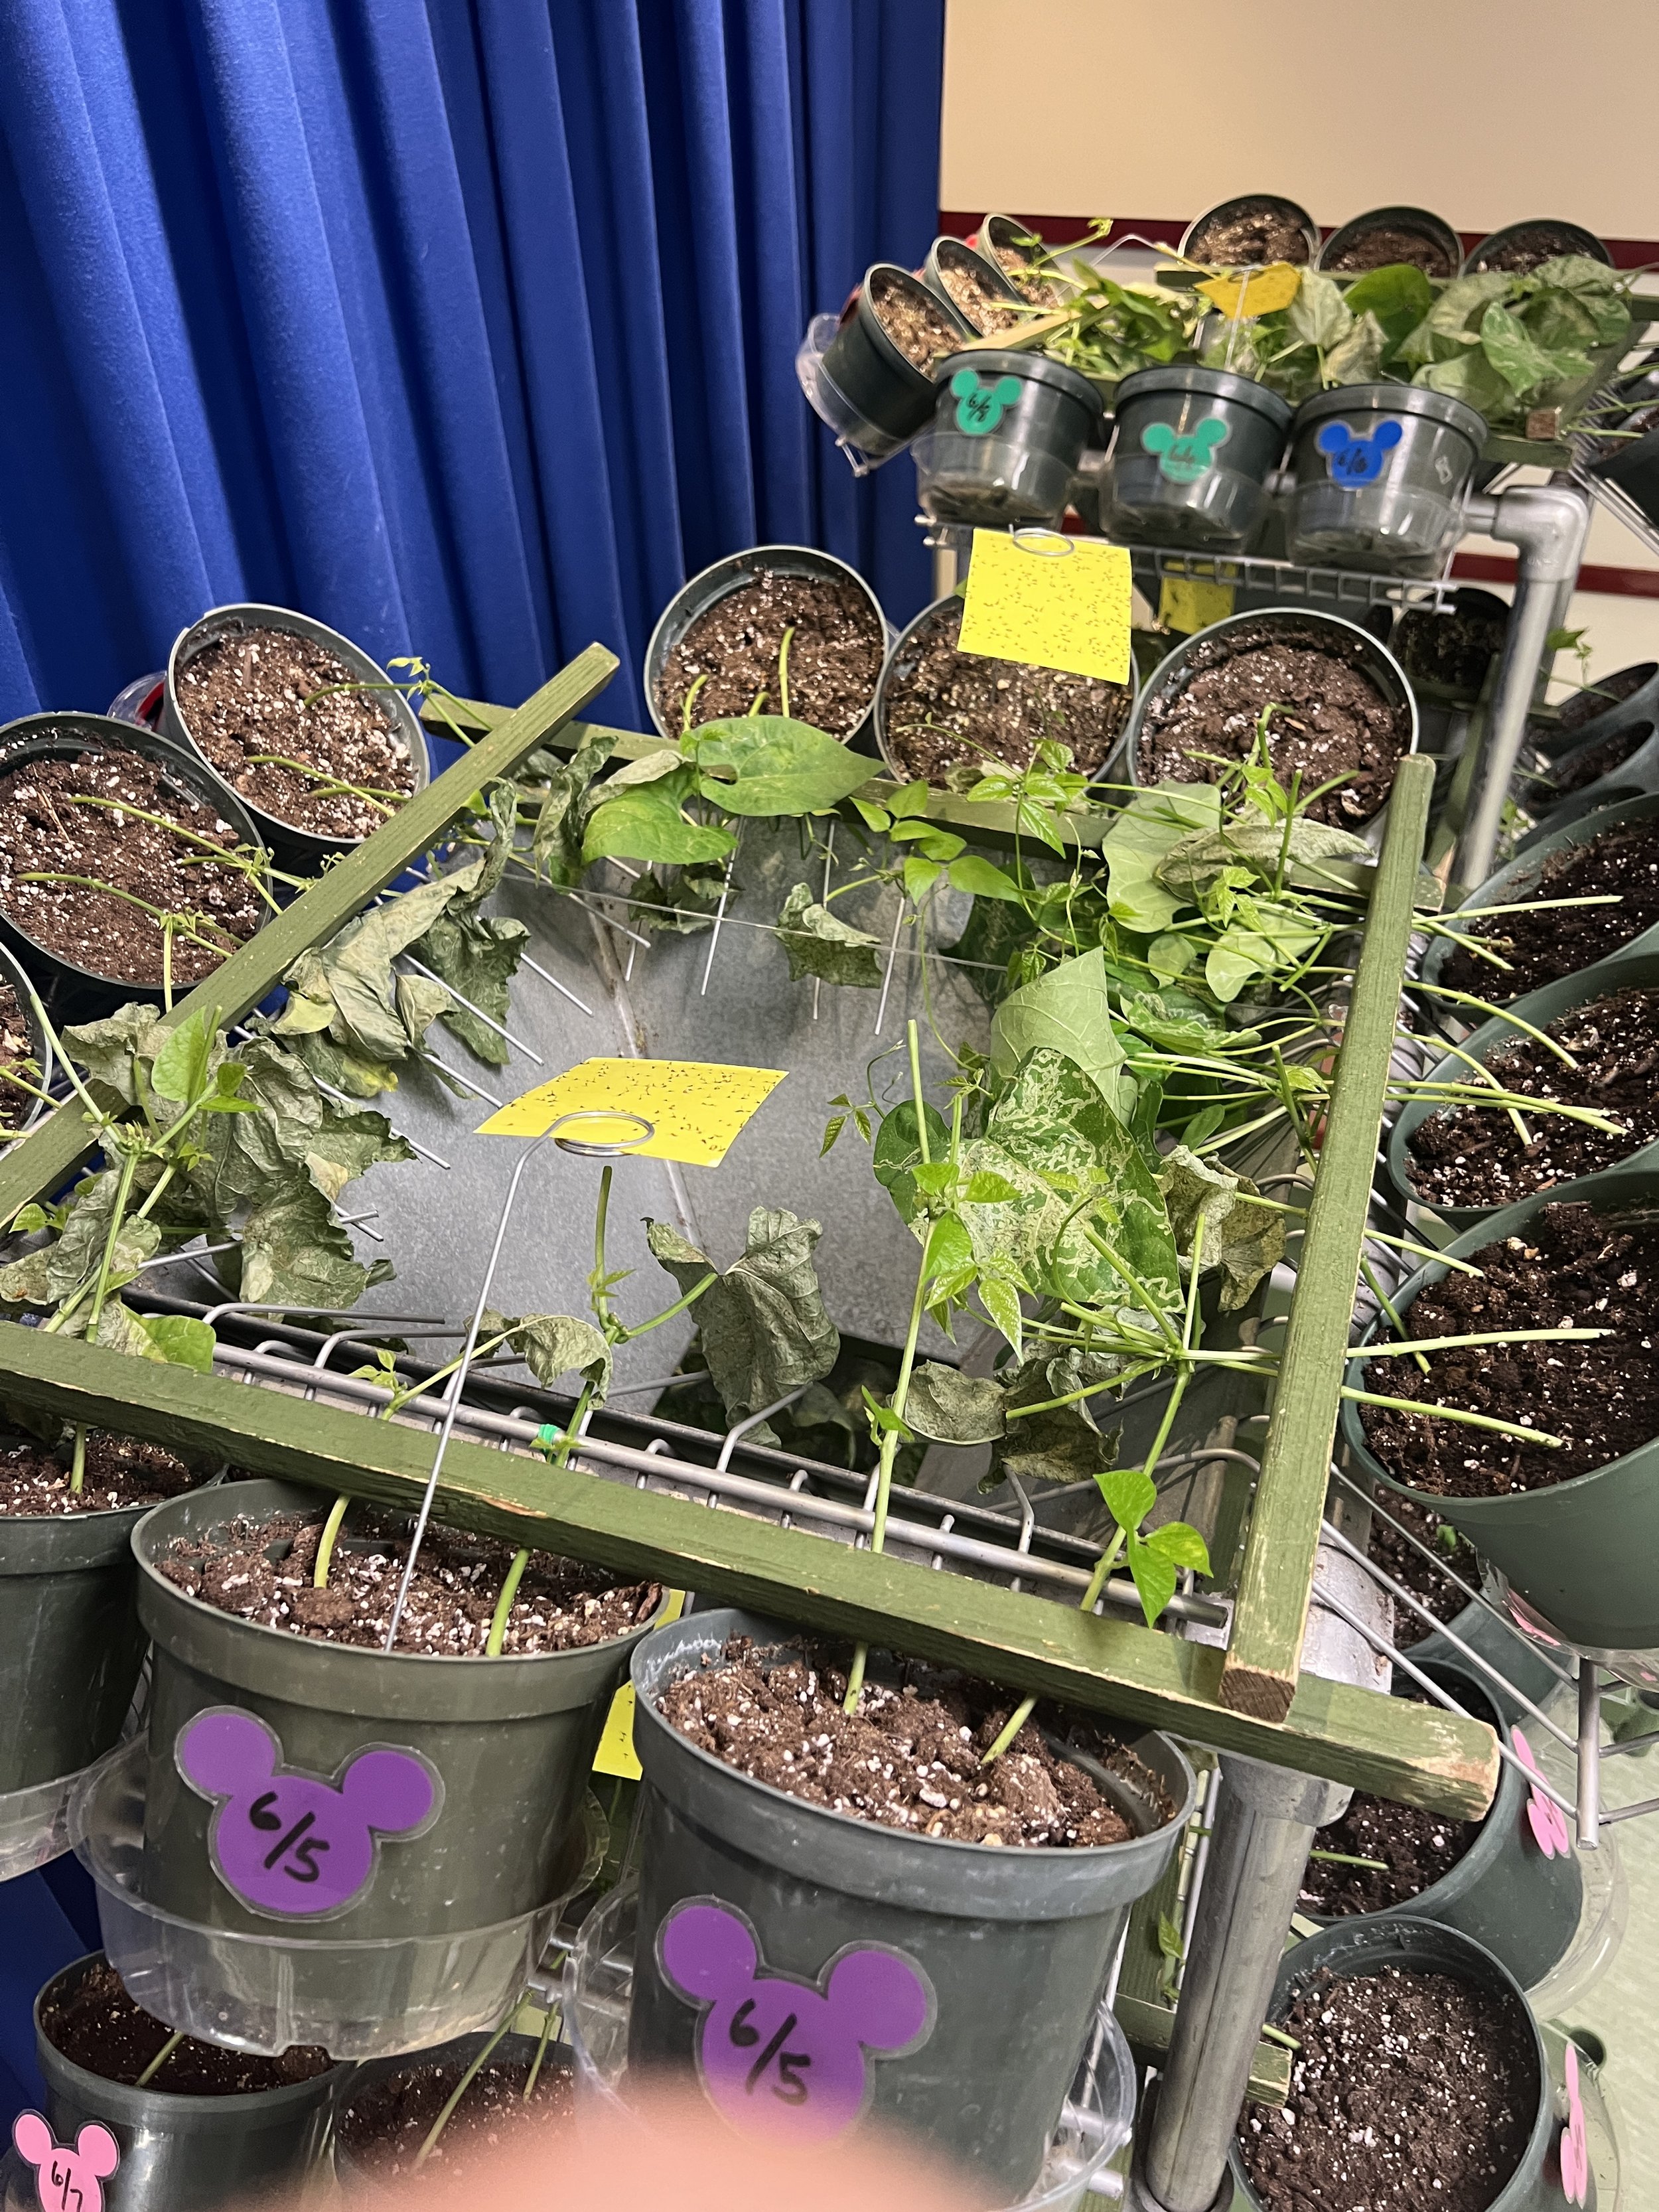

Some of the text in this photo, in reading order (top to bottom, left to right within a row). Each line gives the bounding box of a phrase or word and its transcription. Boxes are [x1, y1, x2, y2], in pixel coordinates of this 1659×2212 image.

[250, 1791, 330, 1882] 6/5
[729, 1998, 811, 2106] 6/5
[51, 2160, 83, 2212] 6/7
